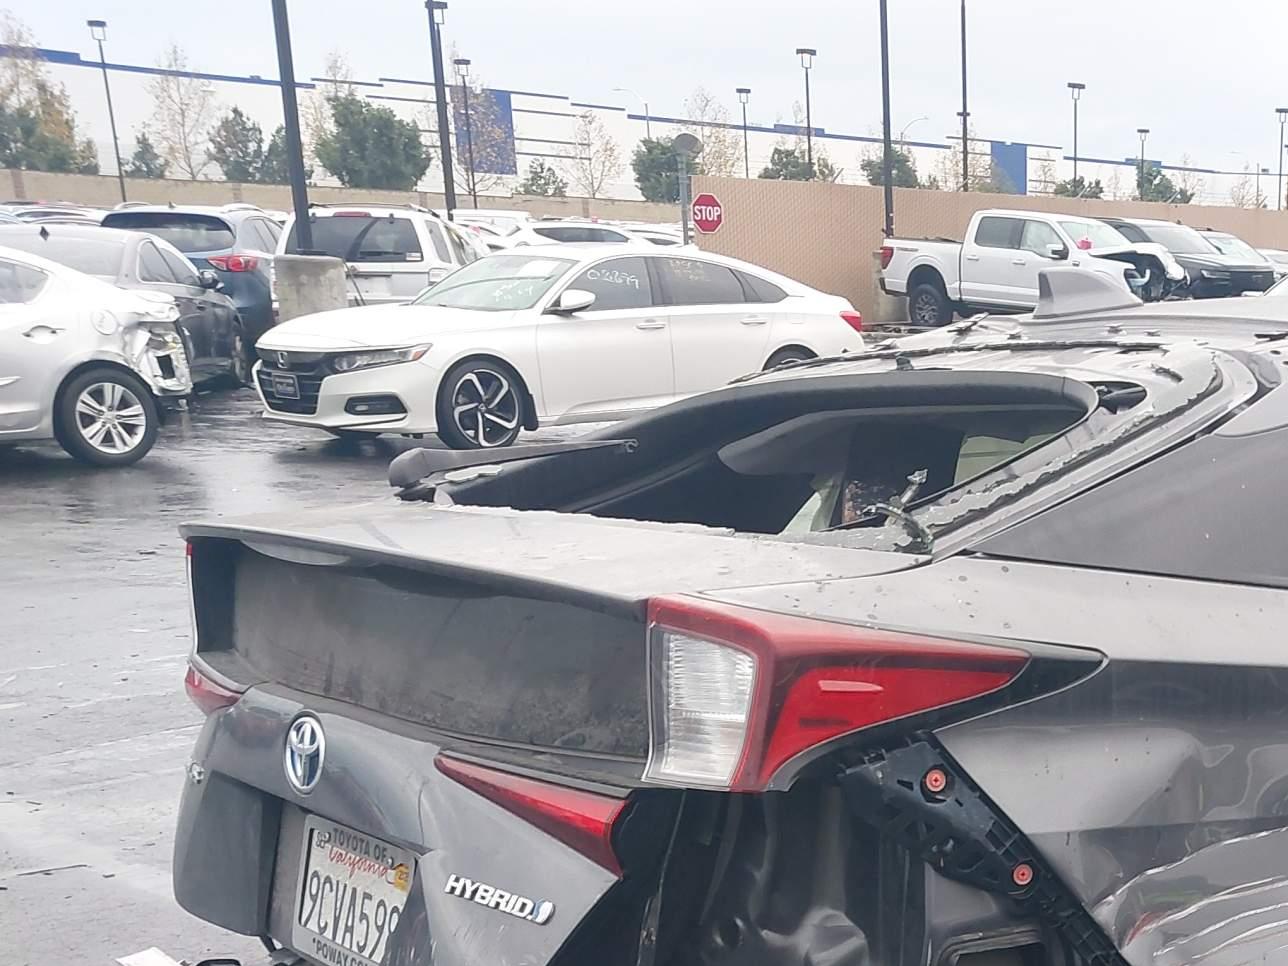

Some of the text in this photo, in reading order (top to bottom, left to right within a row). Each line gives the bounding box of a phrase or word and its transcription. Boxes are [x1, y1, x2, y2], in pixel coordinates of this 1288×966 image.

[694, 205, 721, 221] STOP
[333, 828, 370, 857] TOYOTA
[374, 844, 388, 863] OF
[303, 869, 400, 960] 9CVA599
[444, 873, 535, 918] HYBRID
